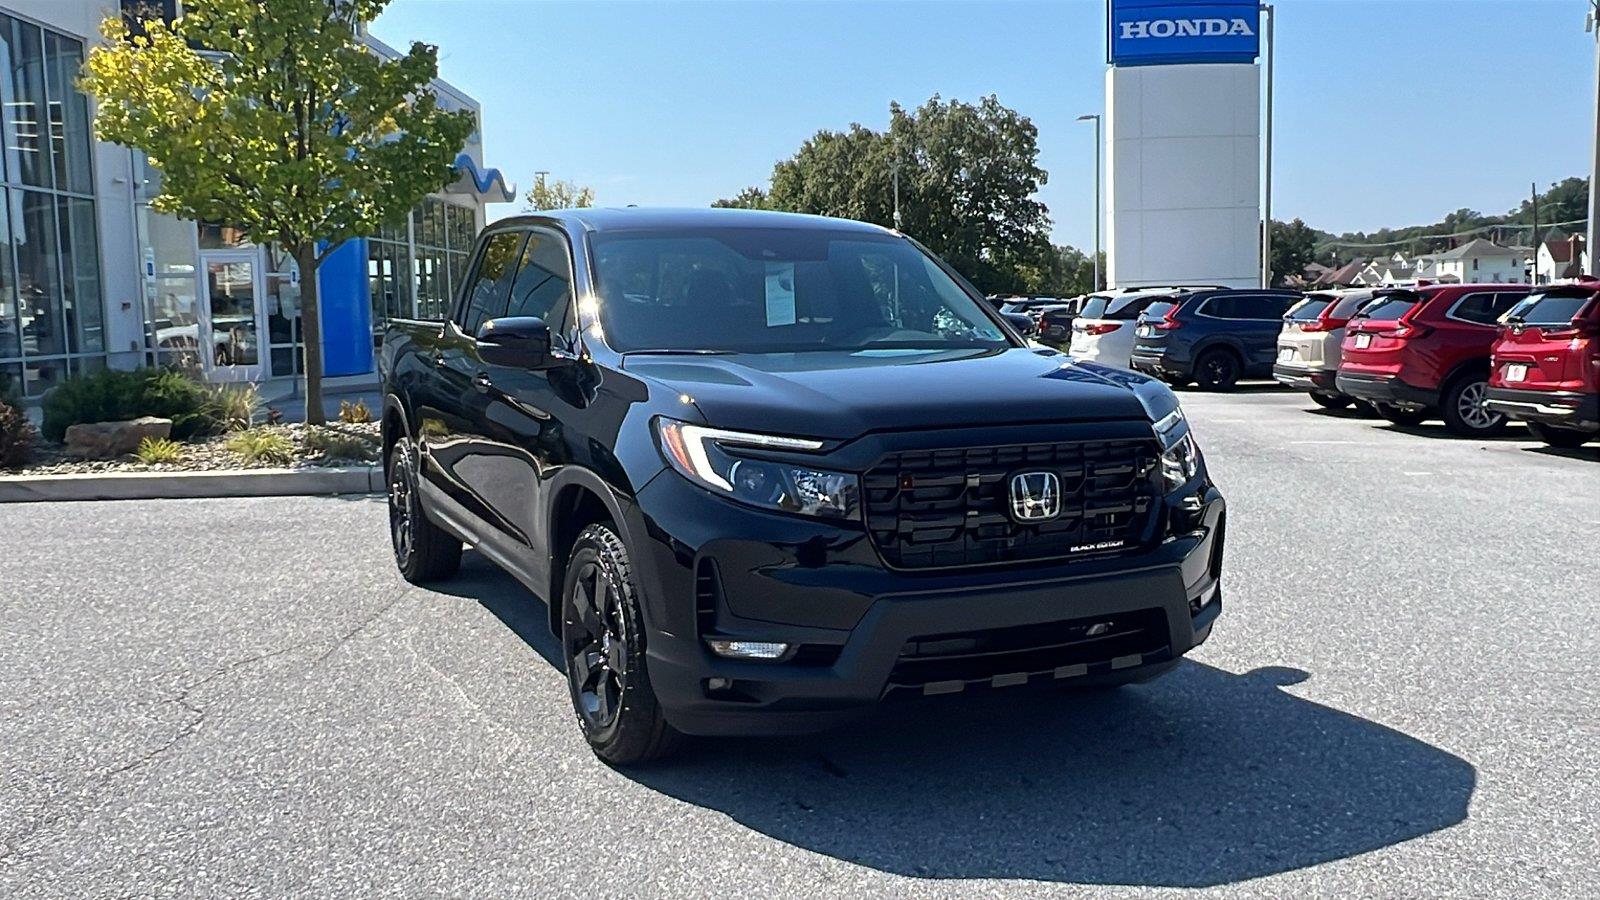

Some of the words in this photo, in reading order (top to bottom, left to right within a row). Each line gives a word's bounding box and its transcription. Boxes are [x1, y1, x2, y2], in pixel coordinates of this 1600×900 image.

[1120, 18, 1255, 39] HONDA
[1070, 544, 1096, 552] BLACK
[1096, 540, 1124, 549] EDITION
